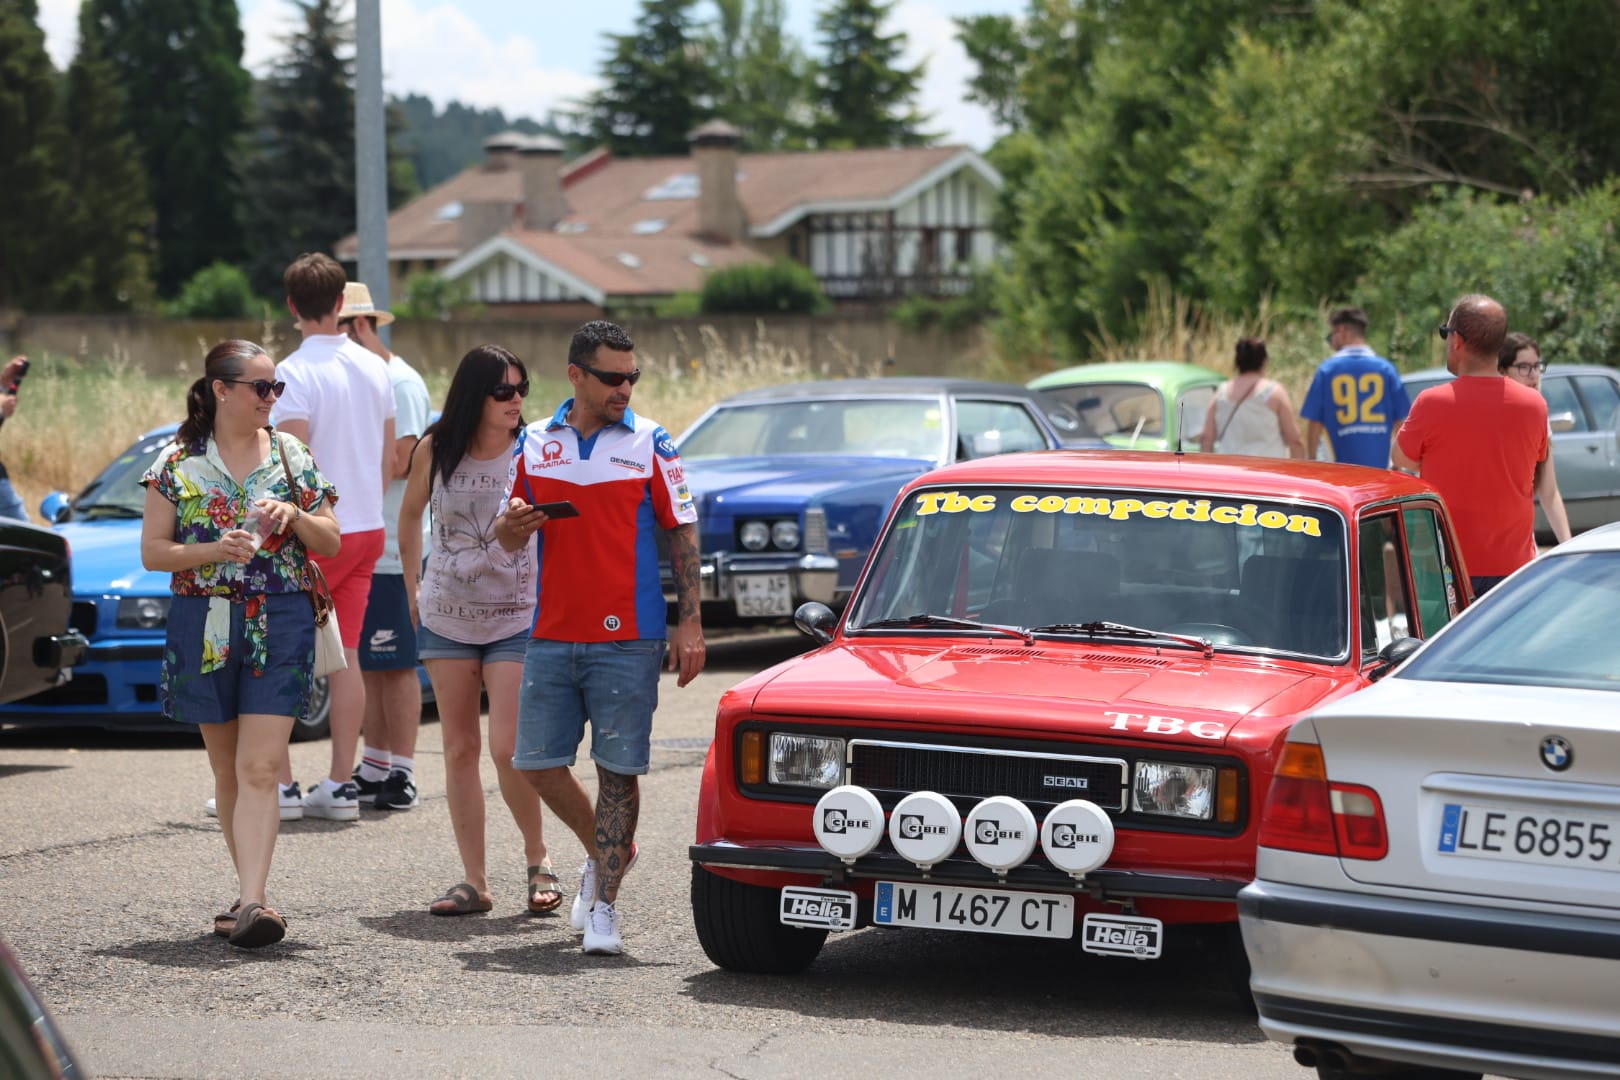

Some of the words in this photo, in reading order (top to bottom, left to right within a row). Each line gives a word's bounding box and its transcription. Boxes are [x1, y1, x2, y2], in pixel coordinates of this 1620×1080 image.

[1331, 372, 1386, 425] 92
[531, 458, 573, 471] PRAMAC
[609, 456, 646, 470] GENERAC
[916, 491, 997, 516] Tbc
[1010, 494, 1322, 537] competicion
[1043, 775, 1088, 789] SEAT
[1458, 810, 1507, 852] LE
[1514, 816, 1612, 861] 6855
[791, 898, 844, 918] Hella
[880, 906, 889, 917] E
[897, 887, 917, 921] M
[932, 890, 1011, 928] 1467
[1021, 898, 1060, 932] CT
[1094, 926, 1149, 946] Hella
